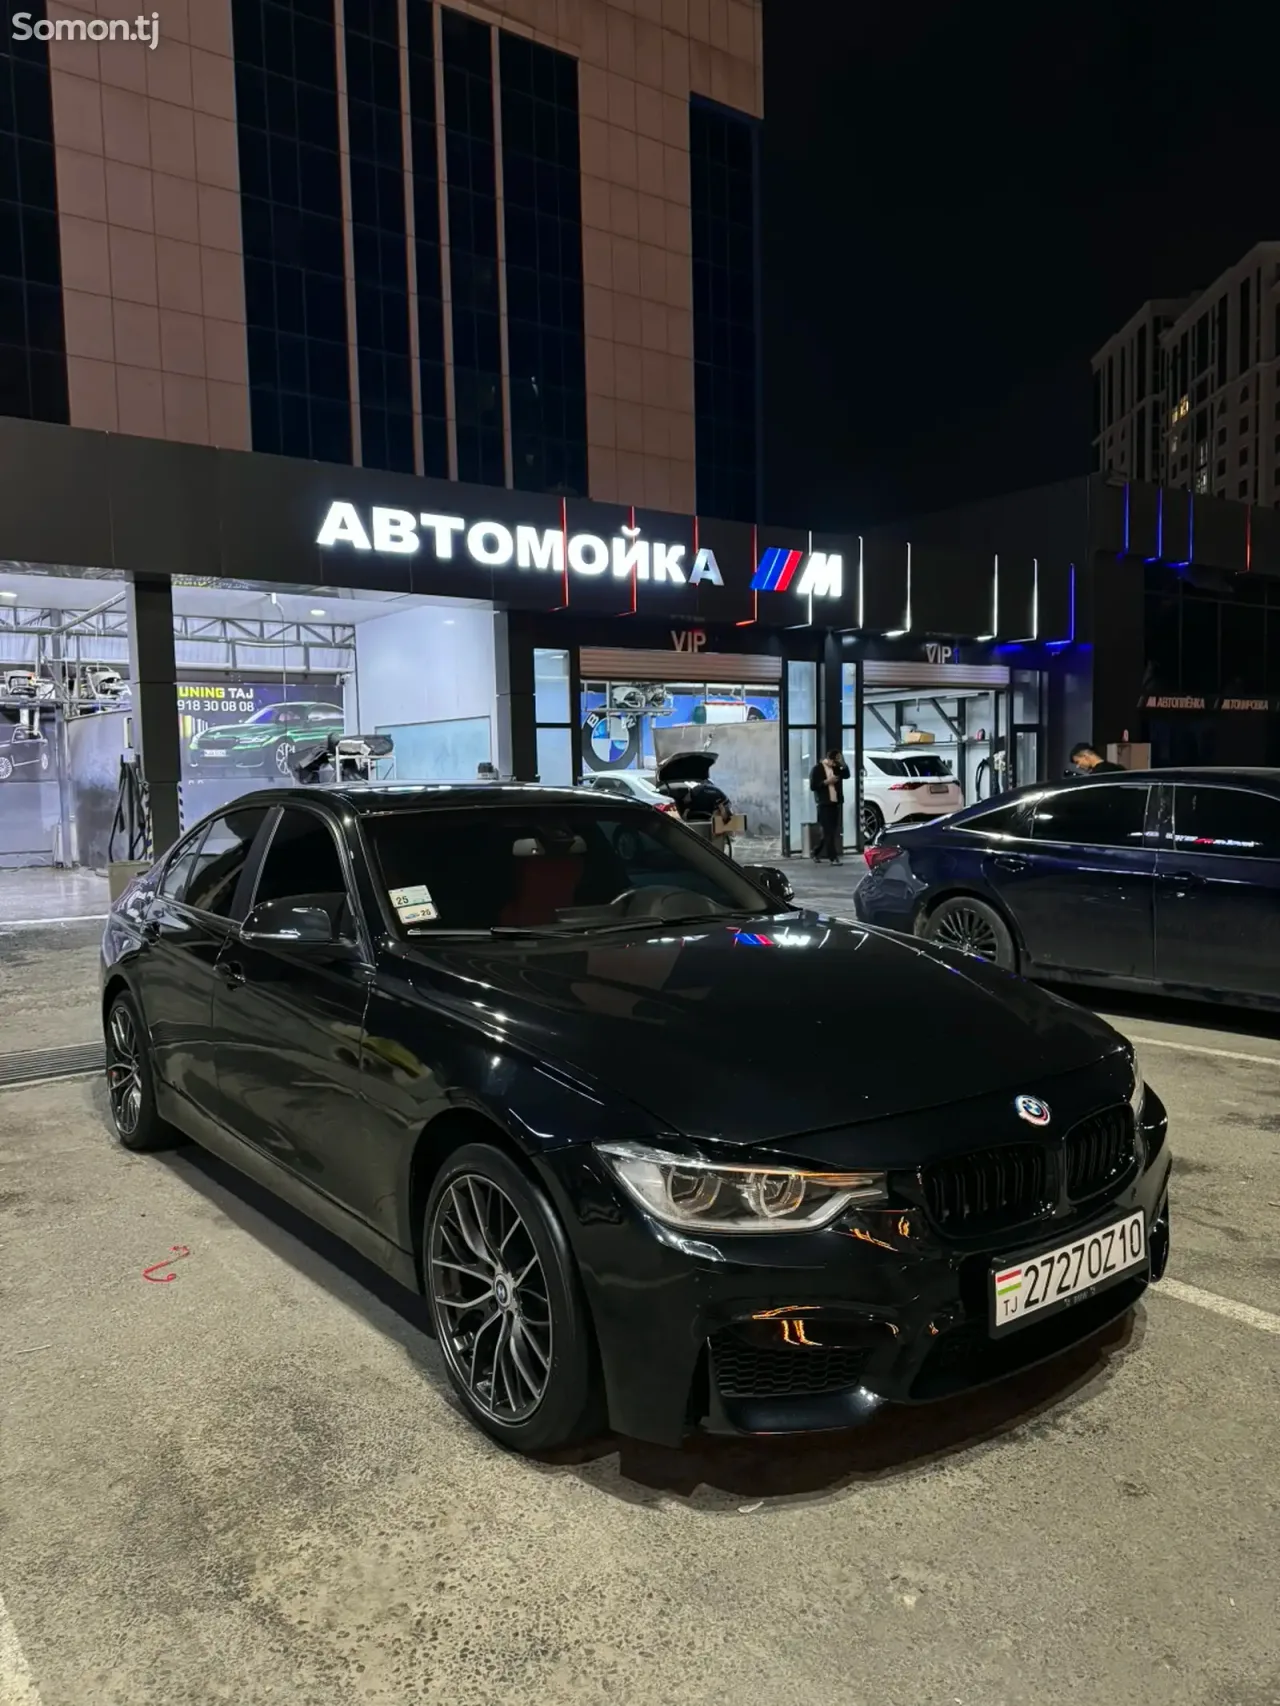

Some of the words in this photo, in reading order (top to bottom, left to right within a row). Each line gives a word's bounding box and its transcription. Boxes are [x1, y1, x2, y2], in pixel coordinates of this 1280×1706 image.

[316, 500, 725, 586] АВТОМОЙКА
[670, 629, 707, 653] VIP
[925, 643, 952, 664] VIP
[178, 686, 225, 699] UNING
[228, 687, 254, 699] TAJ
[177, 700, 201, 711] 918
[203, 701, 219, 711] 30
[221, 701, 237, 712] 08
[239, 701, 255, 712] 08
[396, 896, 409, 905] 25
[1003, 1296, 1018, 1316] TJ
